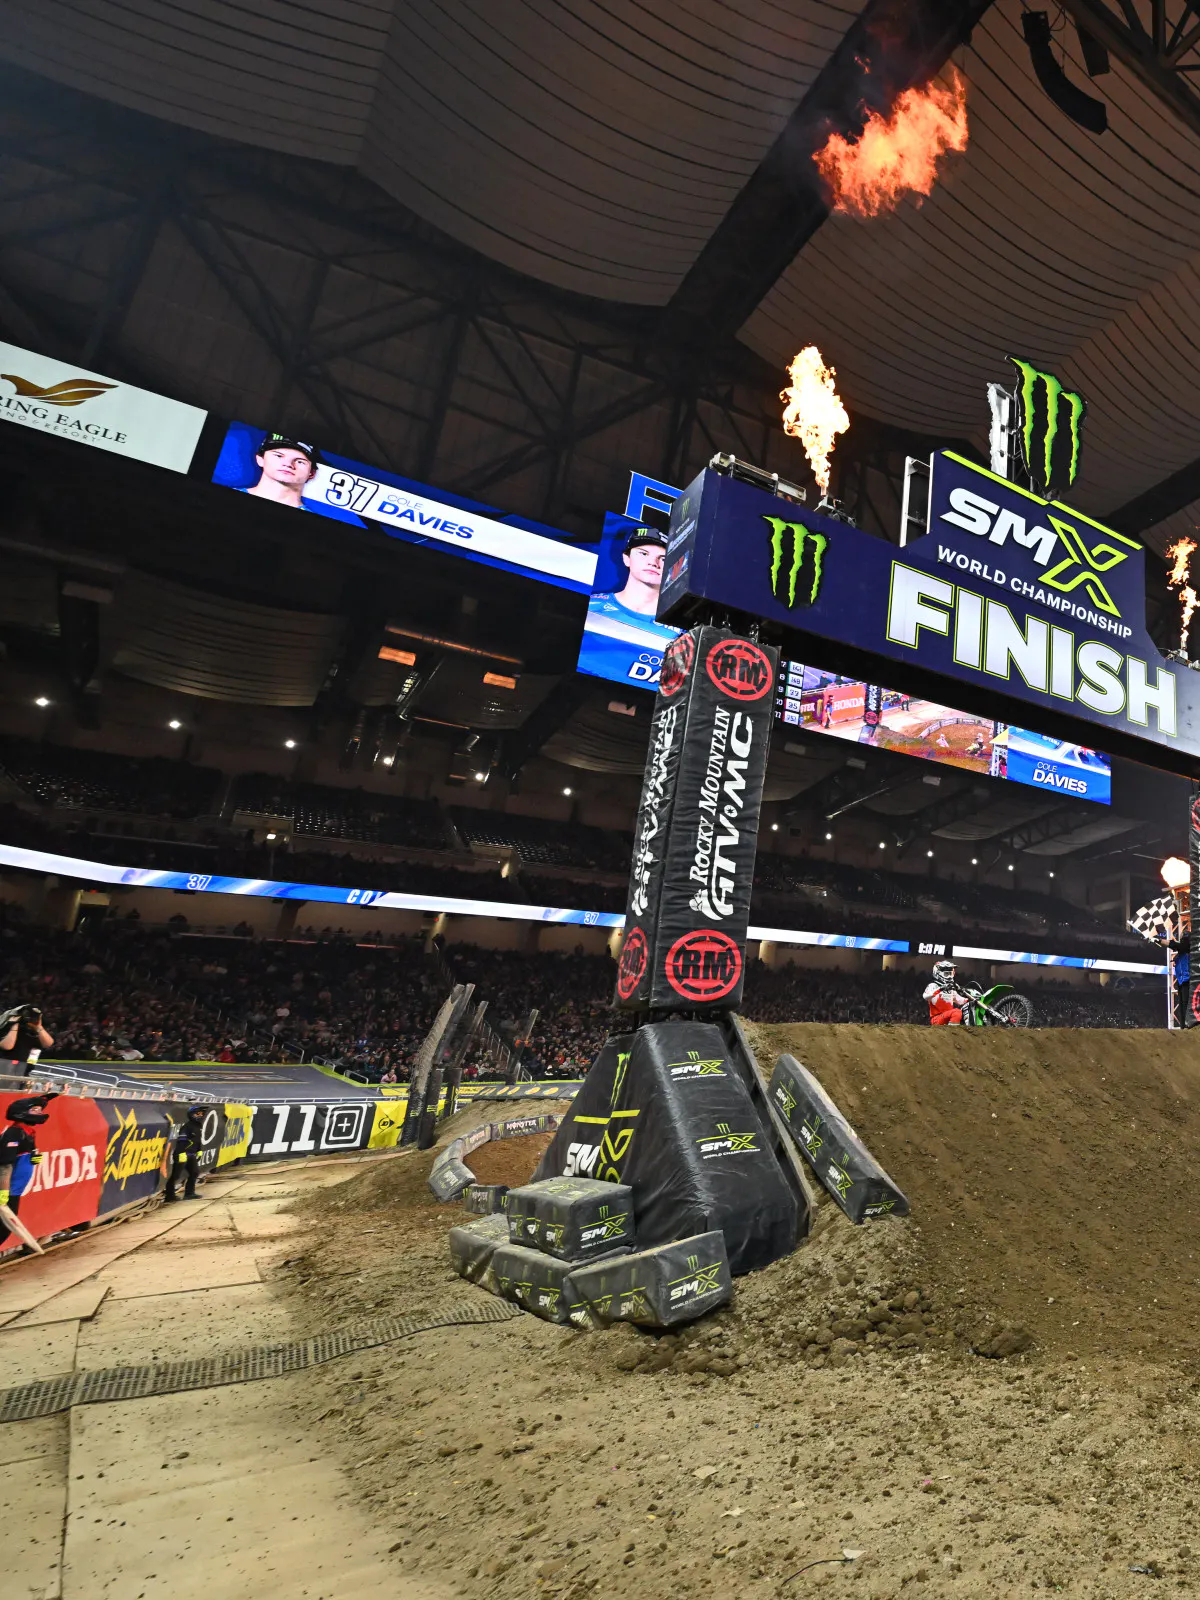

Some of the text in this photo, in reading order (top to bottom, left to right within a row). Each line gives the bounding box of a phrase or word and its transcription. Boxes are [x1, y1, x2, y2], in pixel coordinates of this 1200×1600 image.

[45, 424, 96, 442] RESORT
[55, 413, 128, 444] EAGLE
[325, 471, 380, 513] 37
[387, 494, 424, 510] COLE
[377, 500, 475, 539] DAVIES
[939, 487, 1129, 618] SMX
[938, 544, 1133, 639] WORLD CHAMPIONSHIP
[885, 559, 1177, 738] FINISH
[832, 697, 865, 710] HONDA
[1037, 761, 1058, 773] COLE
[1032, 769, 1088, 794] DAVIES
[690, 704, 731, 883] ROCKY MOUNTAIN
[187, 874, 212, 891] 37
[584, 911, 599, 925] 37
[933, 943, 946, 956] PM
[669, 1060, 725, 1076] SMX
[700, 1135, 757, 1153] SMX
[702, 1152, 722, 1160] WORLD
[581, 1217, 625, 1241] SMX
[669, 1267, 719, 1300] SMX
[670, 1299, 689, 1310] WORLD
